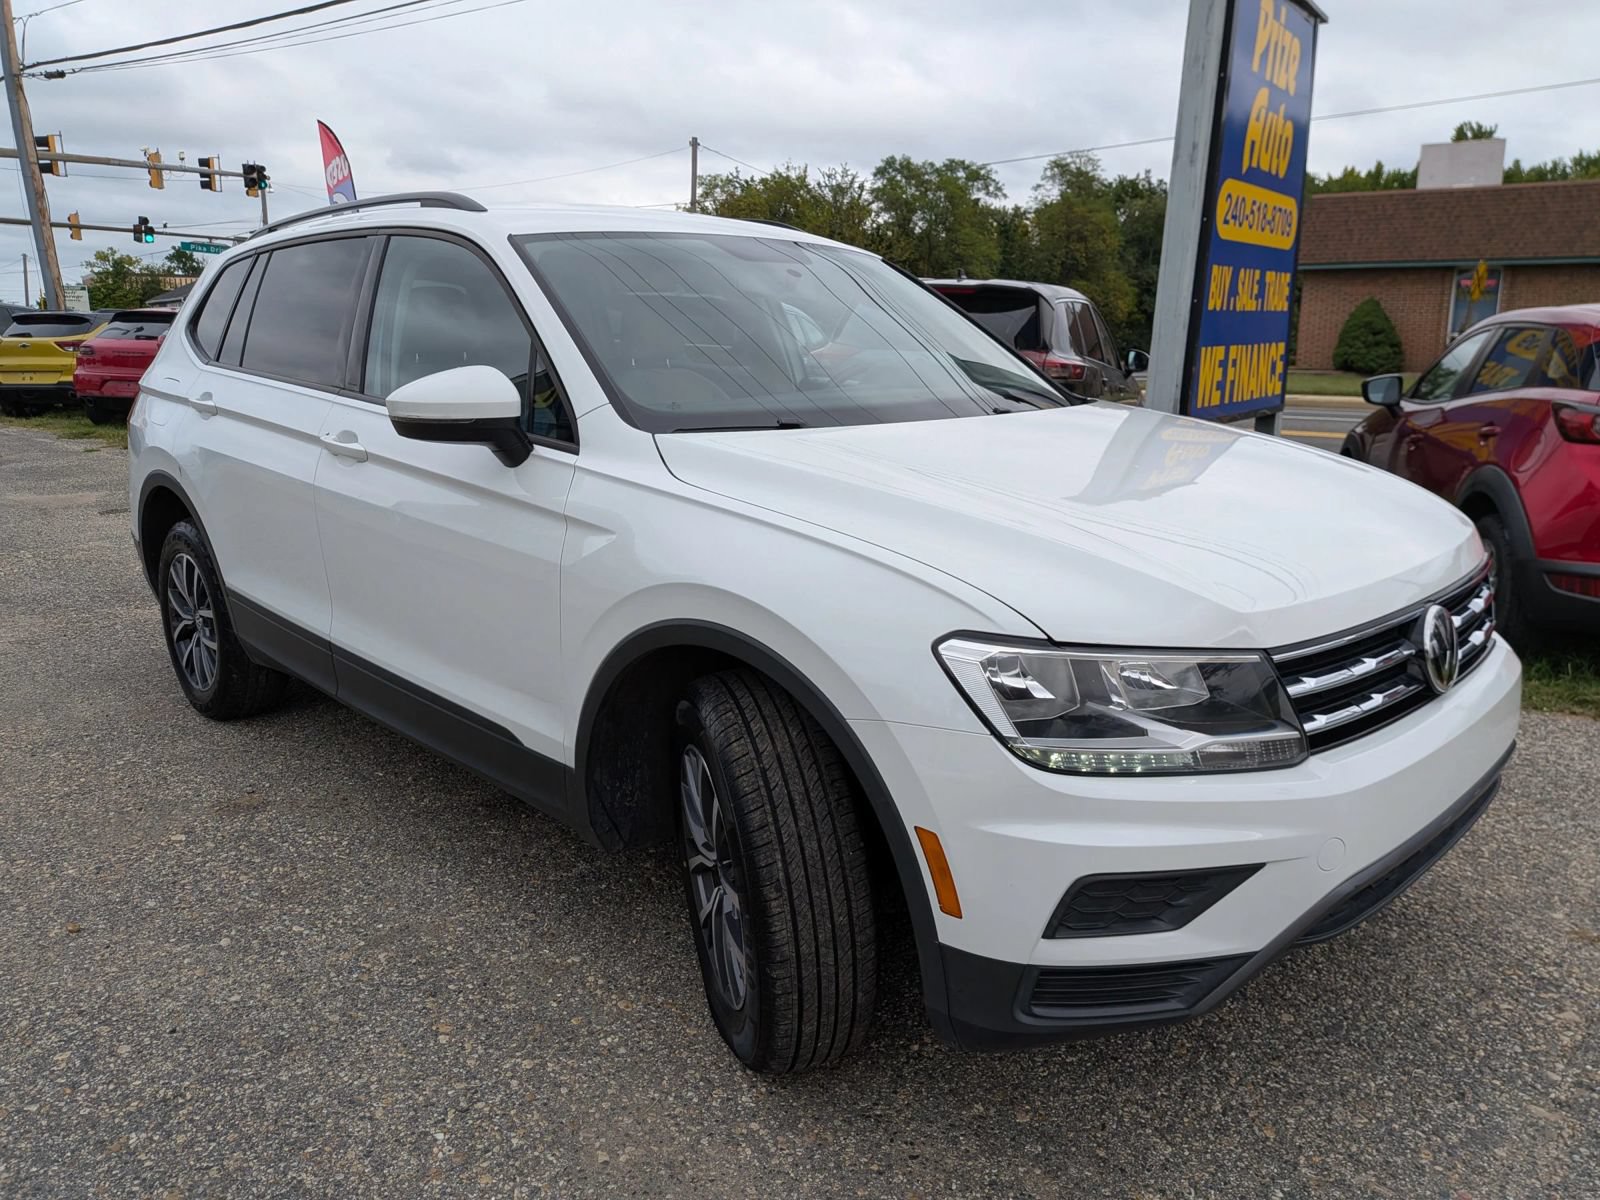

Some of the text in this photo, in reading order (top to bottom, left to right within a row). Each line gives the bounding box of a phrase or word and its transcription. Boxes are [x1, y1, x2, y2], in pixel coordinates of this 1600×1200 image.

[1252, 0, 1300, 96] Prize
[1242, 87, 1294, 179] Auto
[1264, 271, 1292, 312] TRADE
[1197, 342, 1286, 408] WE FINANCE
